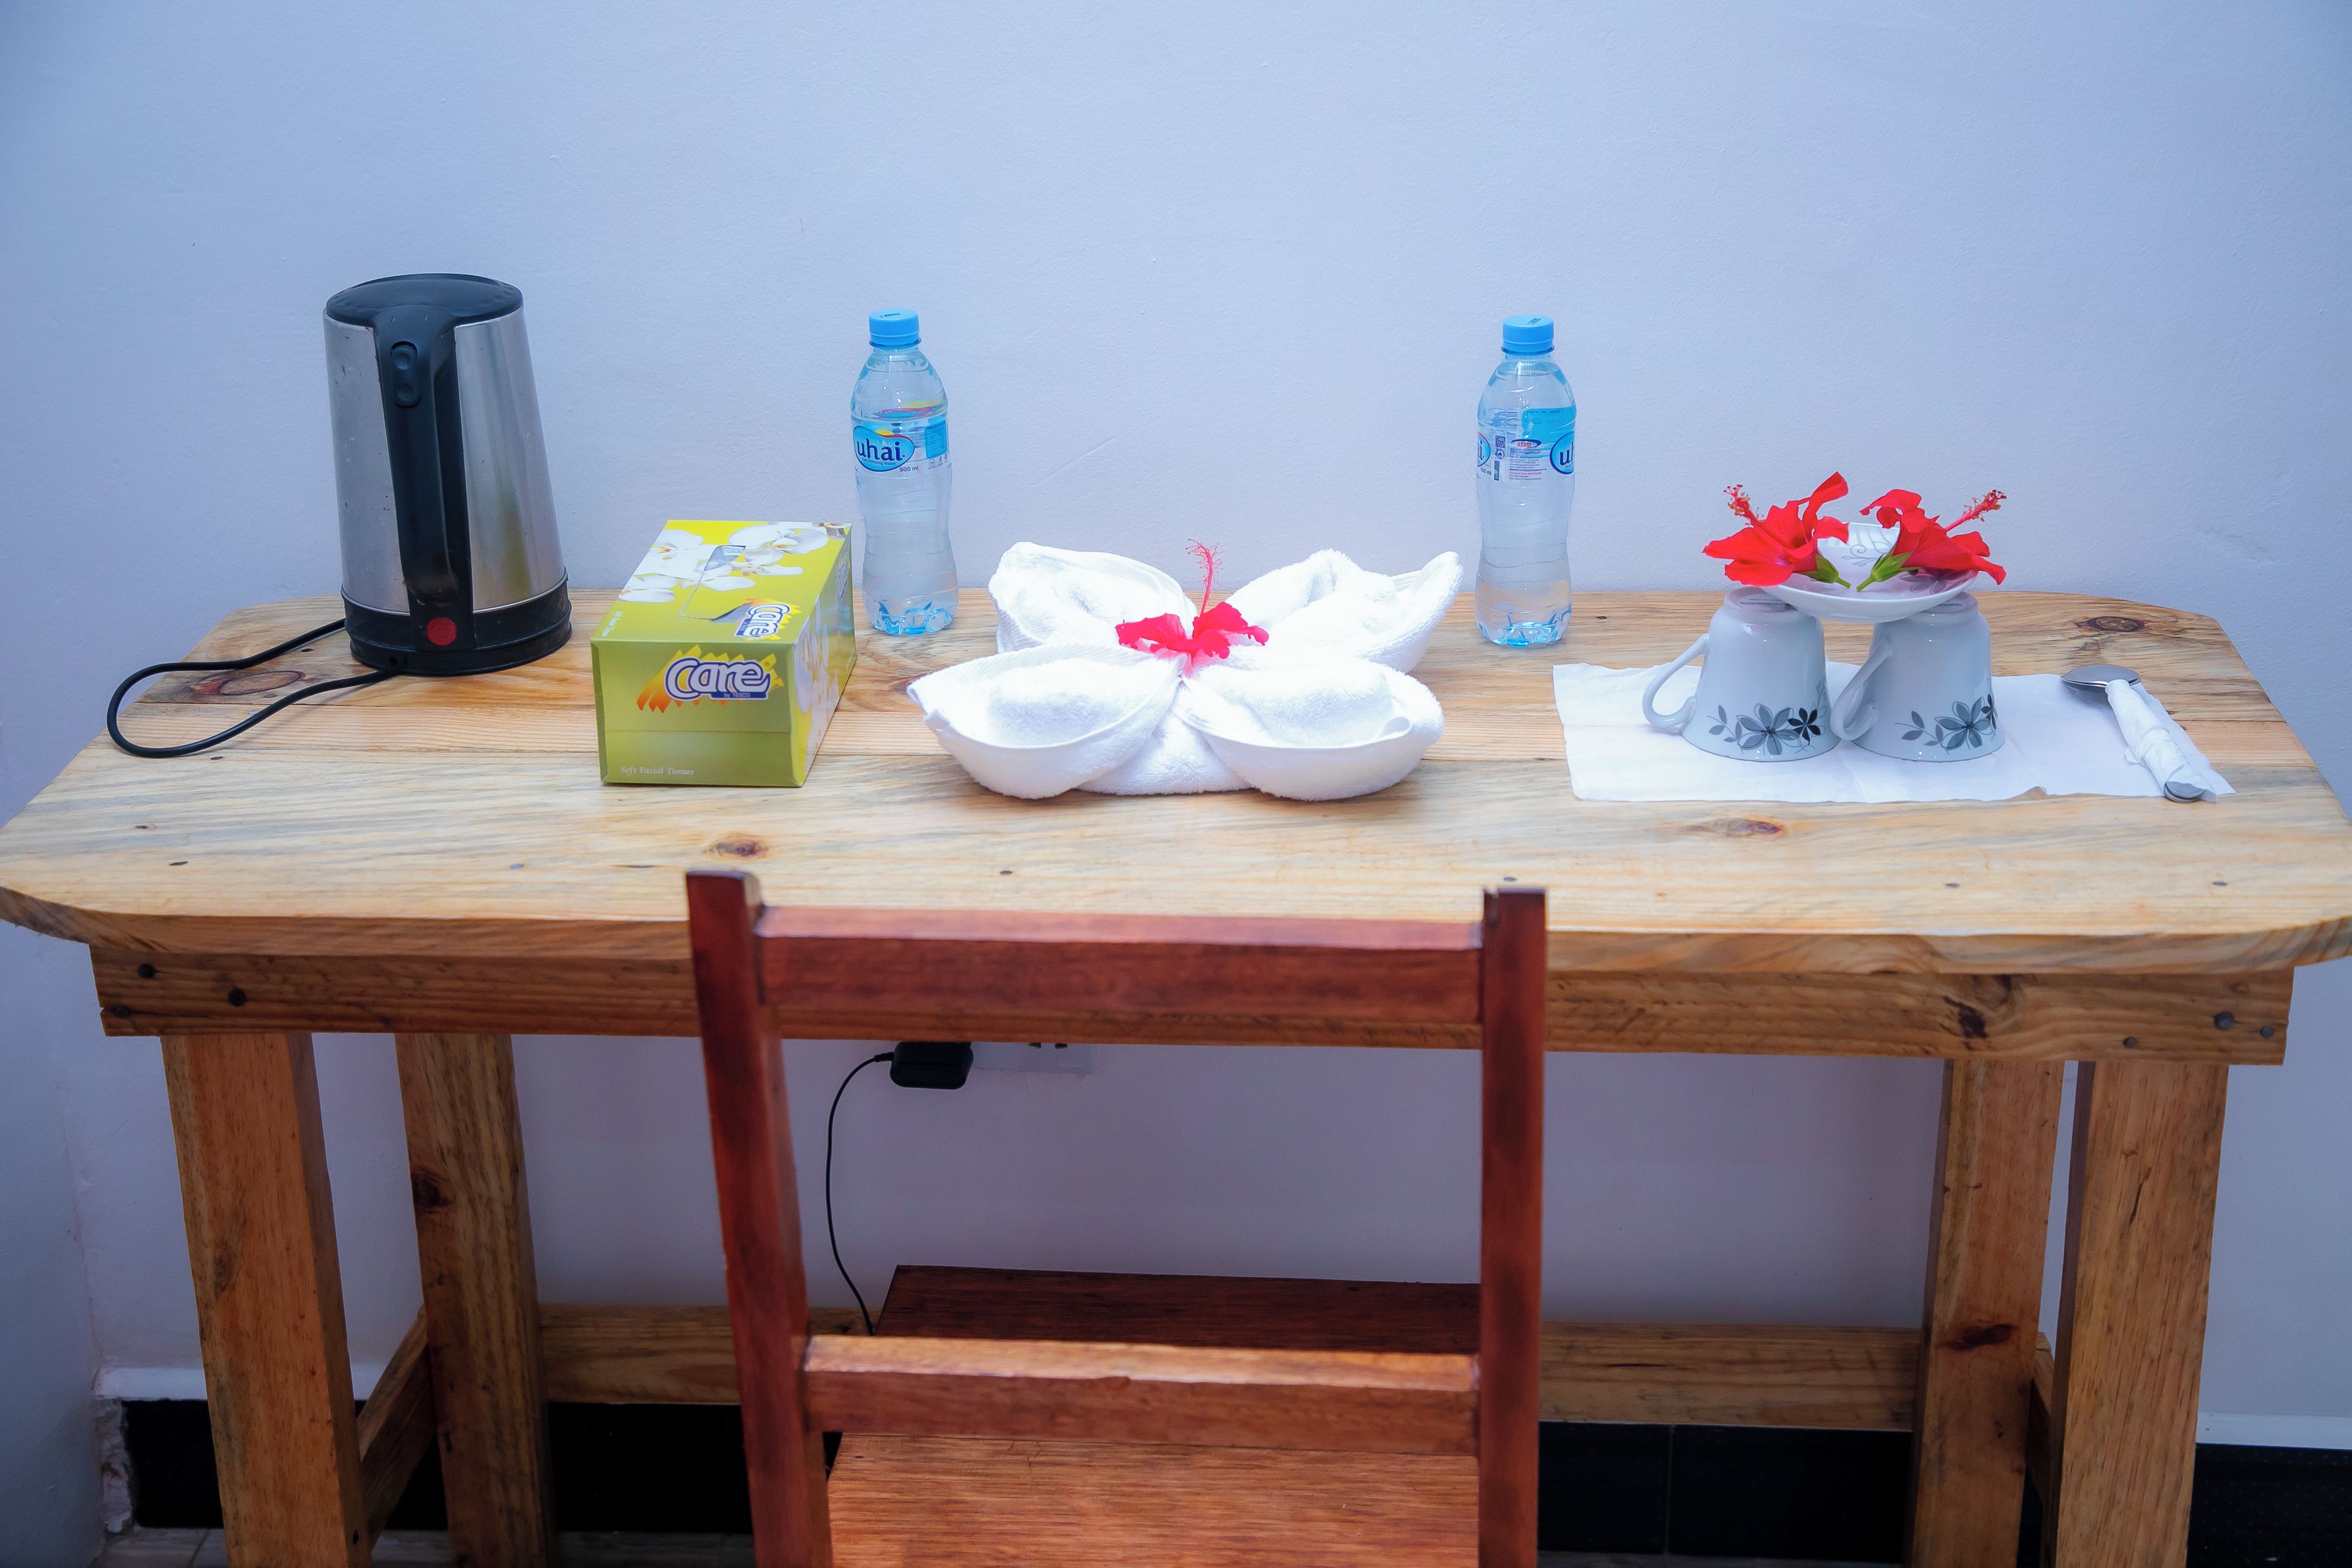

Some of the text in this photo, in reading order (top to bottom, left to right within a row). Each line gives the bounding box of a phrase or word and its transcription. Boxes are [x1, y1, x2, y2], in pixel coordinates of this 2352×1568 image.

[857, 437, 903, 461] uhai
[746, 603, 790, 638] Care
[665, 657, 771, 700] Care
[620, 765, 695, 777] Soft Facial Tissues
